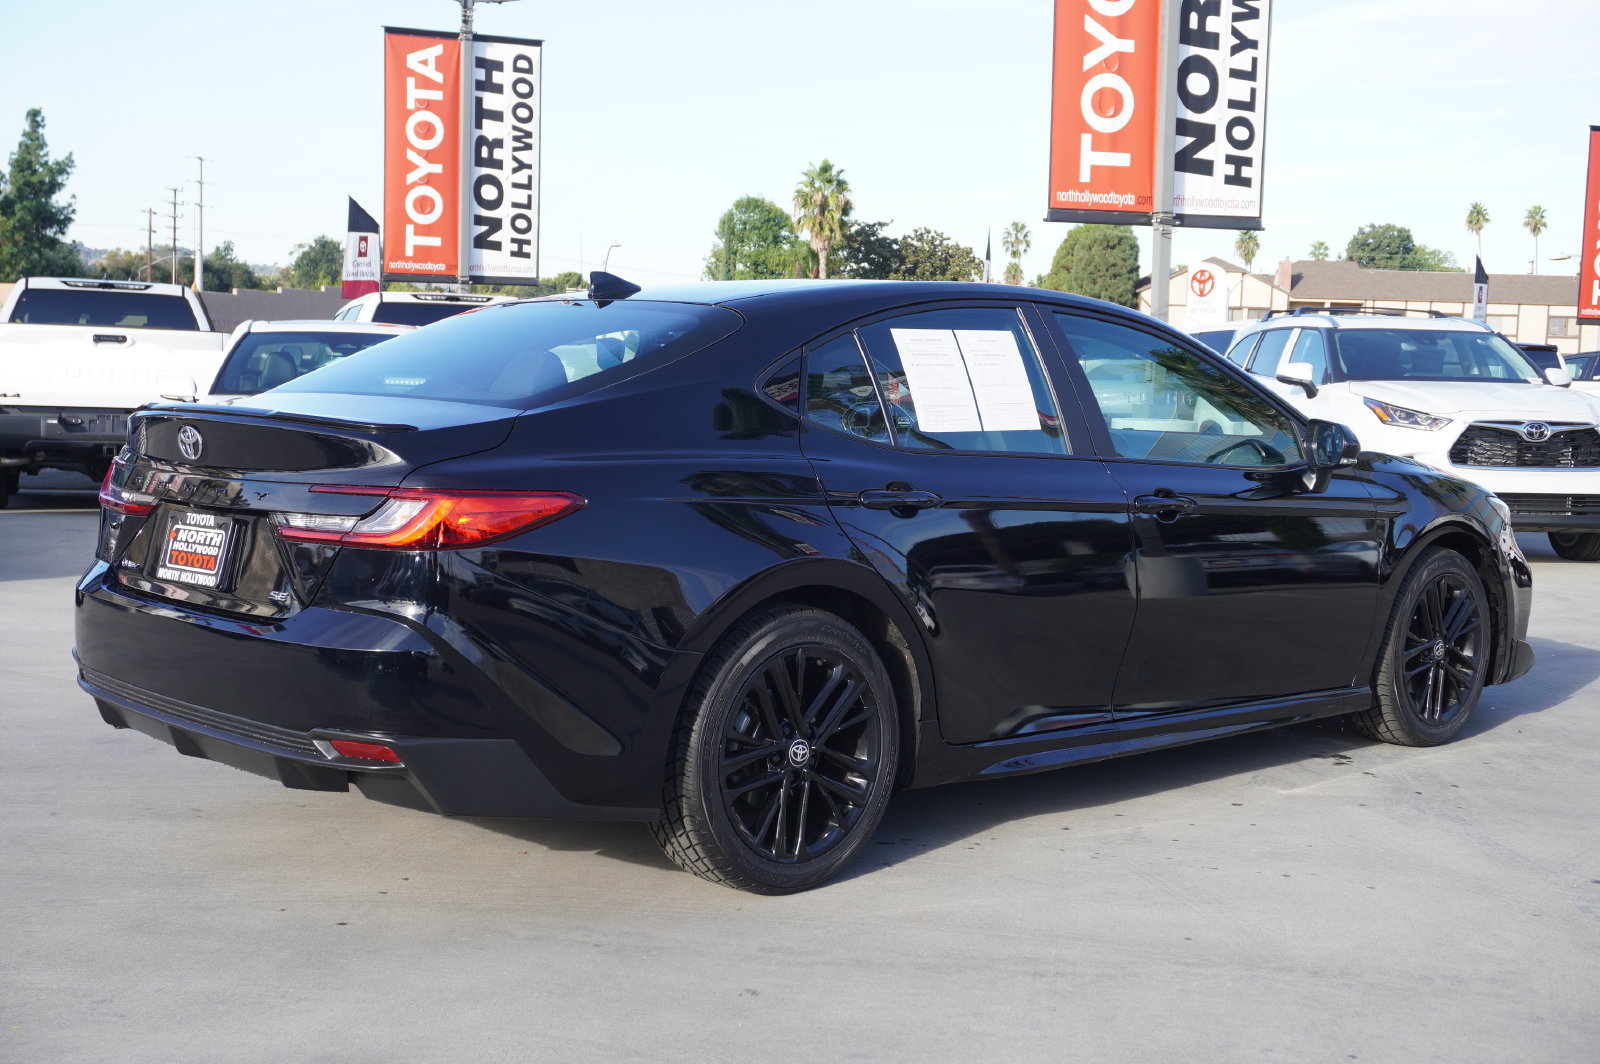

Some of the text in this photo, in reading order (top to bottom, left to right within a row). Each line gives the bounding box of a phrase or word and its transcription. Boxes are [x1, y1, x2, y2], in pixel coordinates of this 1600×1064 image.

[1079, 0, 1136, 183] TOY
[405, 43, 445, 257] TOYOTA
[473, 56, 504, 252] NORTH
[510, 53, 535, 259] HOLLYWOOD
[1056, 188, 1153, 208] northhollywoodtoyota.com
[1173, 194, 1256, 211] rthhollywoodtoyota.com
[352, 259, 372, 268] Cered
[469, 263, 534, 274] orthhollywoodtoyota.com
[186, 512, 215, 527] TOYOTA
[176, 529, 223, 547] NORTH
[172, 541, 219, 556] HOLLYWOOD
[171, 550, 215, 570] TOYOTA
[157, 567, 216, 587] NORTH HOLLYWOOD
